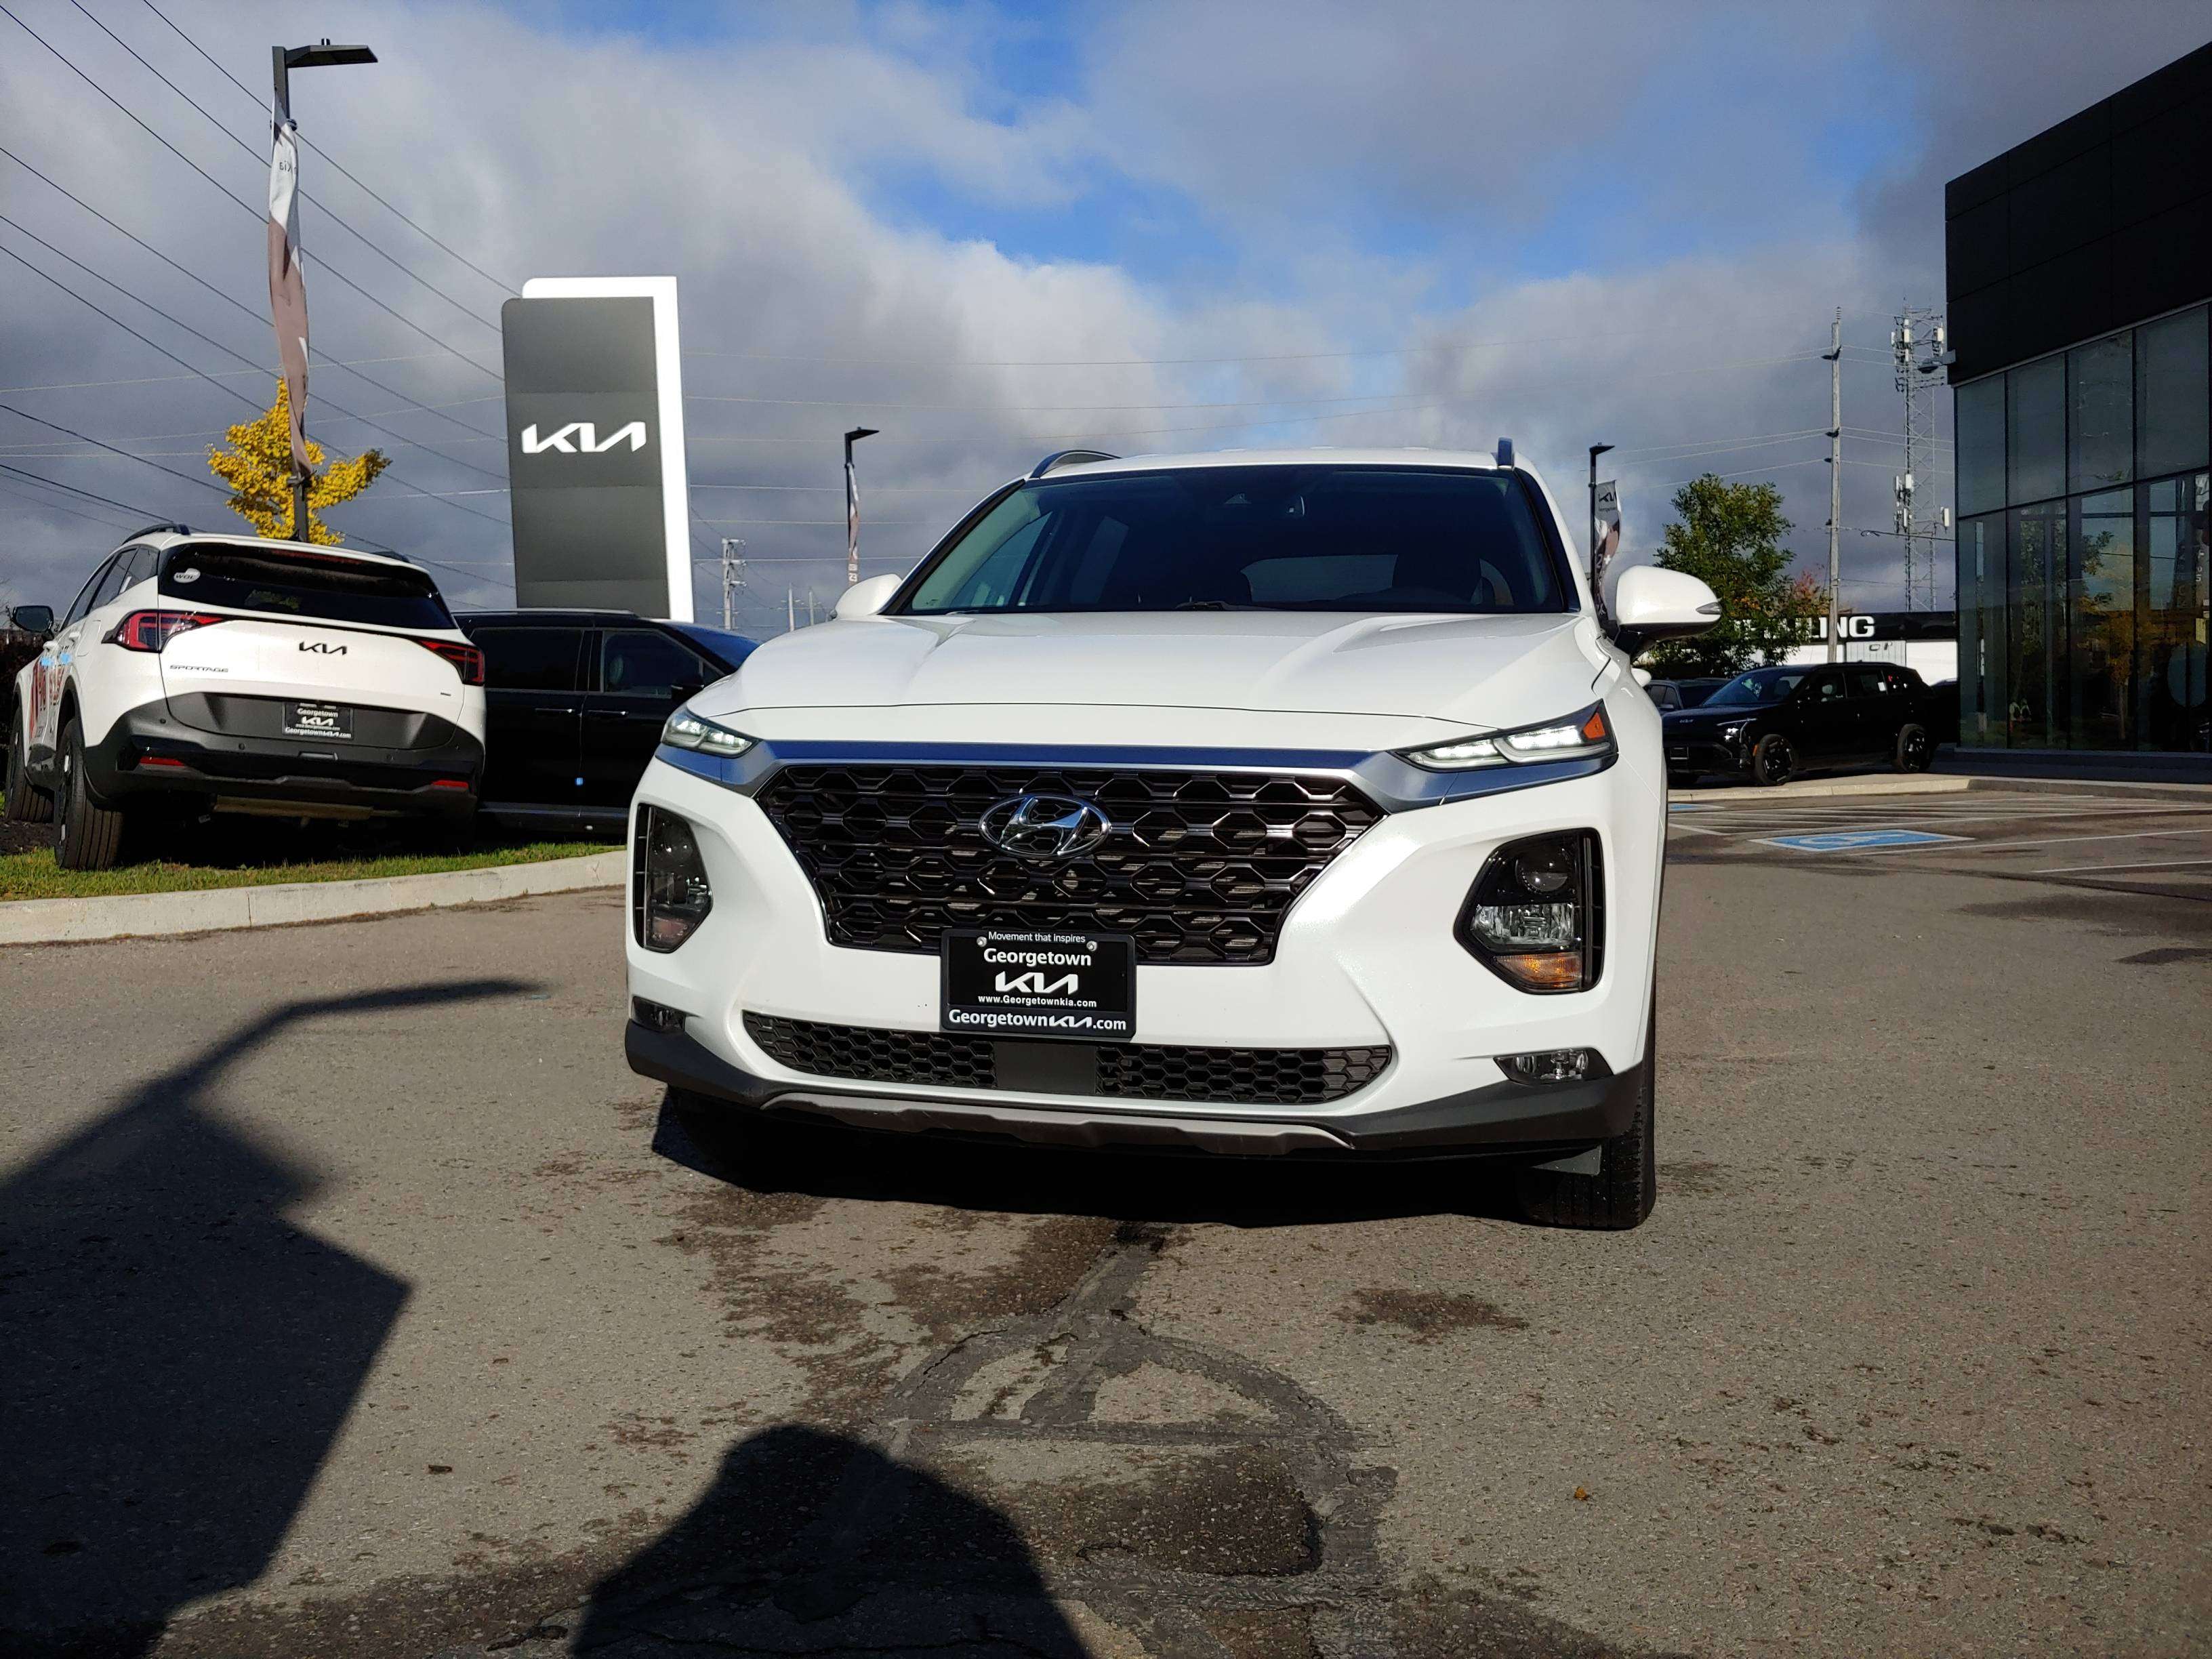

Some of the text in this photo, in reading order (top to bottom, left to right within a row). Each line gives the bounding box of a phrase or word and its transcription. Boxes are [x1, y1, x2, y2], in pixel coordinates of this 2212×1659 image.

[521, 422, 647, 454] KIA
[299, 641, 348, 656] KIA
[169, 664, 229, 673] SPORTAGE
[297, 708, 339, 718] Georgetown
[301, 716, 334, 726] KIA
[989, 931, 1033, 941] Movement
[1035, 933, 1051, 941] that
[983, 947, 1091, 967] Georgetown
[995, 970, 1079, 995] KIA
[977, 994, 1097, 1008] www.Georgetownkia.com
